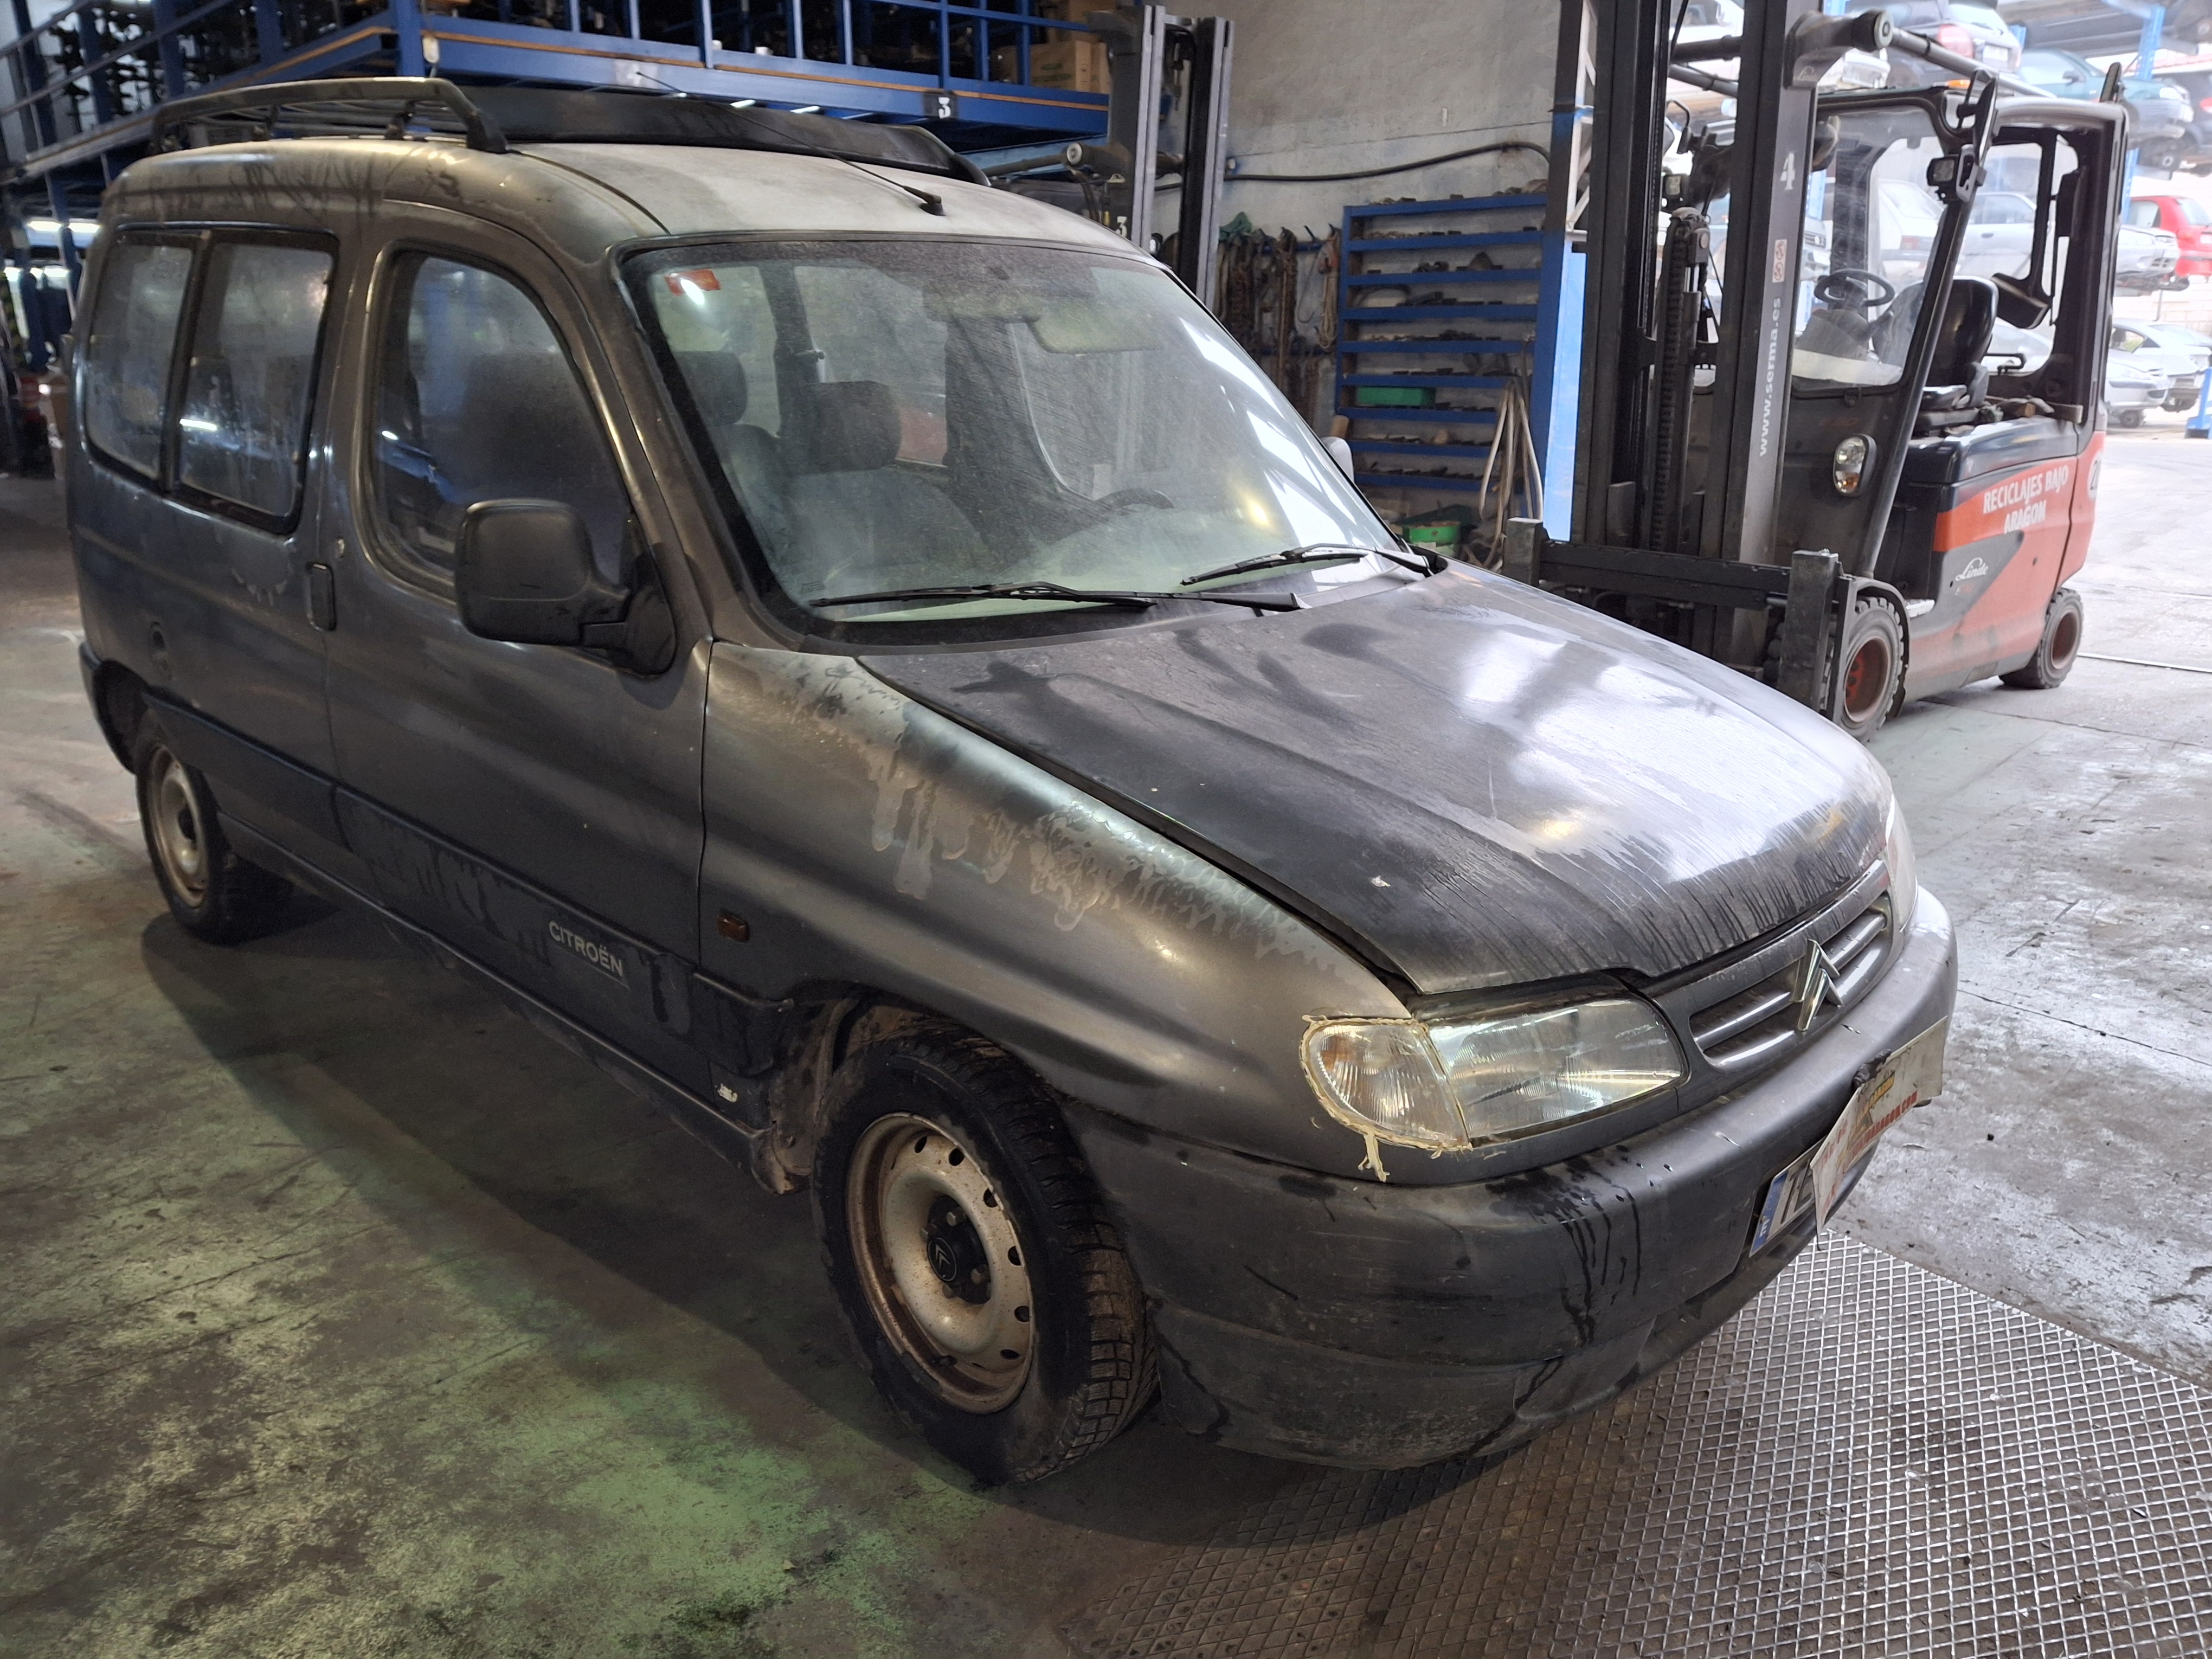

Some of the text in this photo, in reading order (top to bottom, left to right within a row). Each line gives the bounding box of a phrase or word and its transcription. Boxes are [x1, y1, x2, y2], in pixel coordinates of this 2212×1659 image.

[938, 97, 951, 119] 3
[1780, 152, 1796, 190] 4
[1760, 298, 1781, 457] www.serma.es
[1983, 465, 2069, 514] RECICLAJES BAJO
[1955, 557, 1989, 581] Linde
[549, 920, 623, 978] CITROËN
